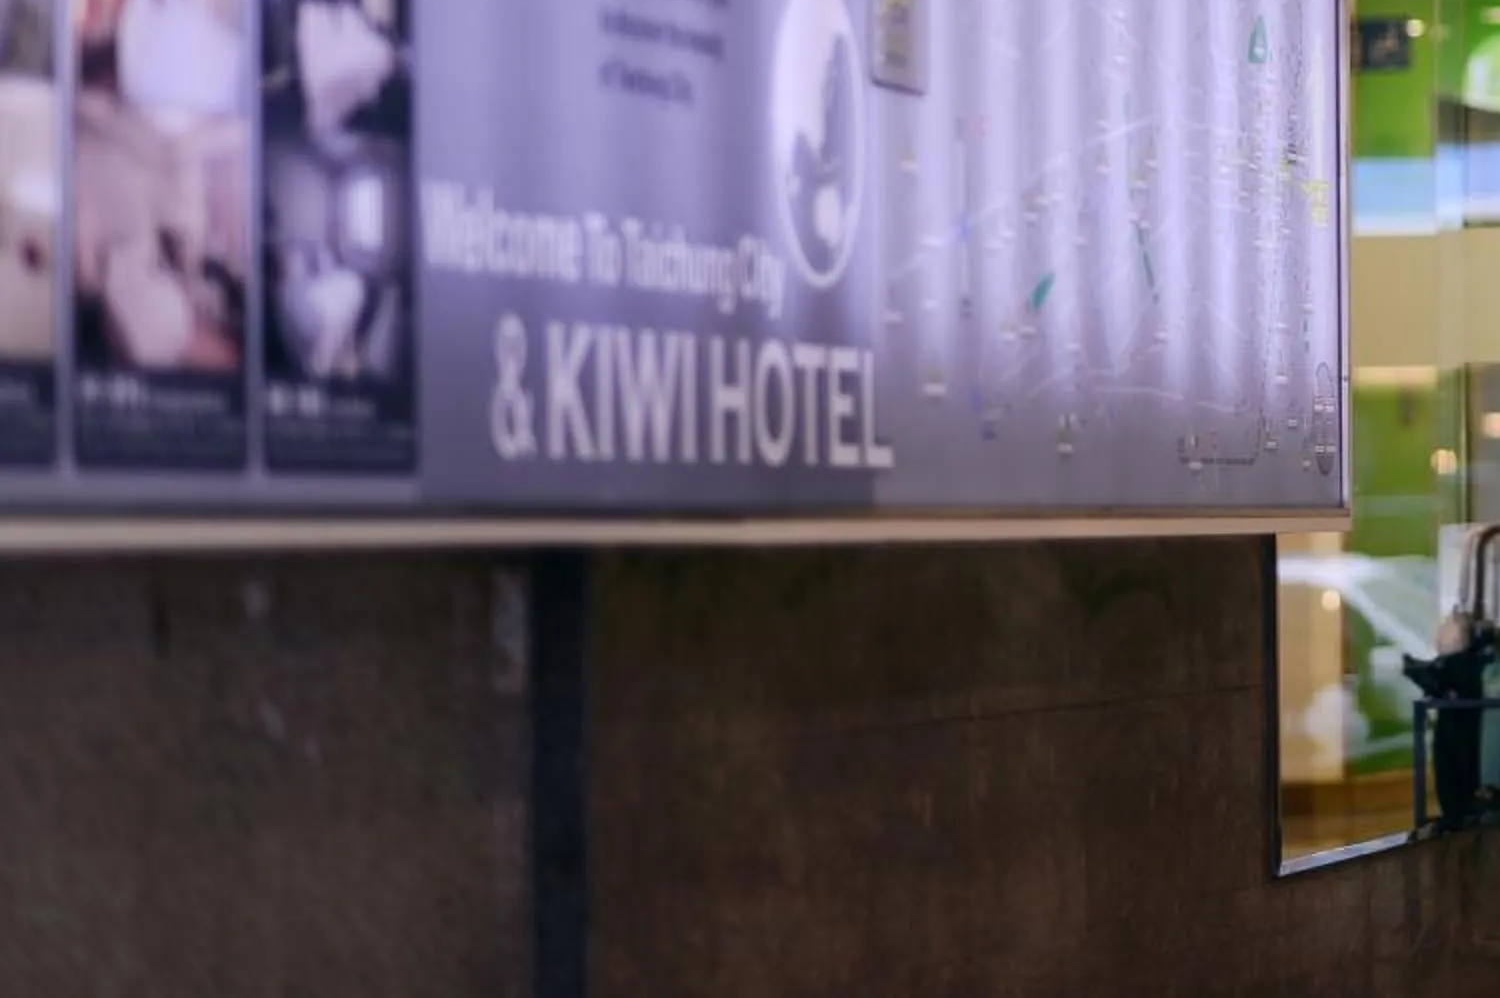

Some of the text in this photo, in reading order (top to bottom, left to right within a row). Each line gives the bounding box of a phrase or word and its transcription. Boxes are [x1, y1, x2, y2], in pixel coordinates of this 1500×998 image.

[491, 313, 537, 461] &
[546, 321, 698, 463] KIWI
[707, 336, 895, 469] HOTEL
